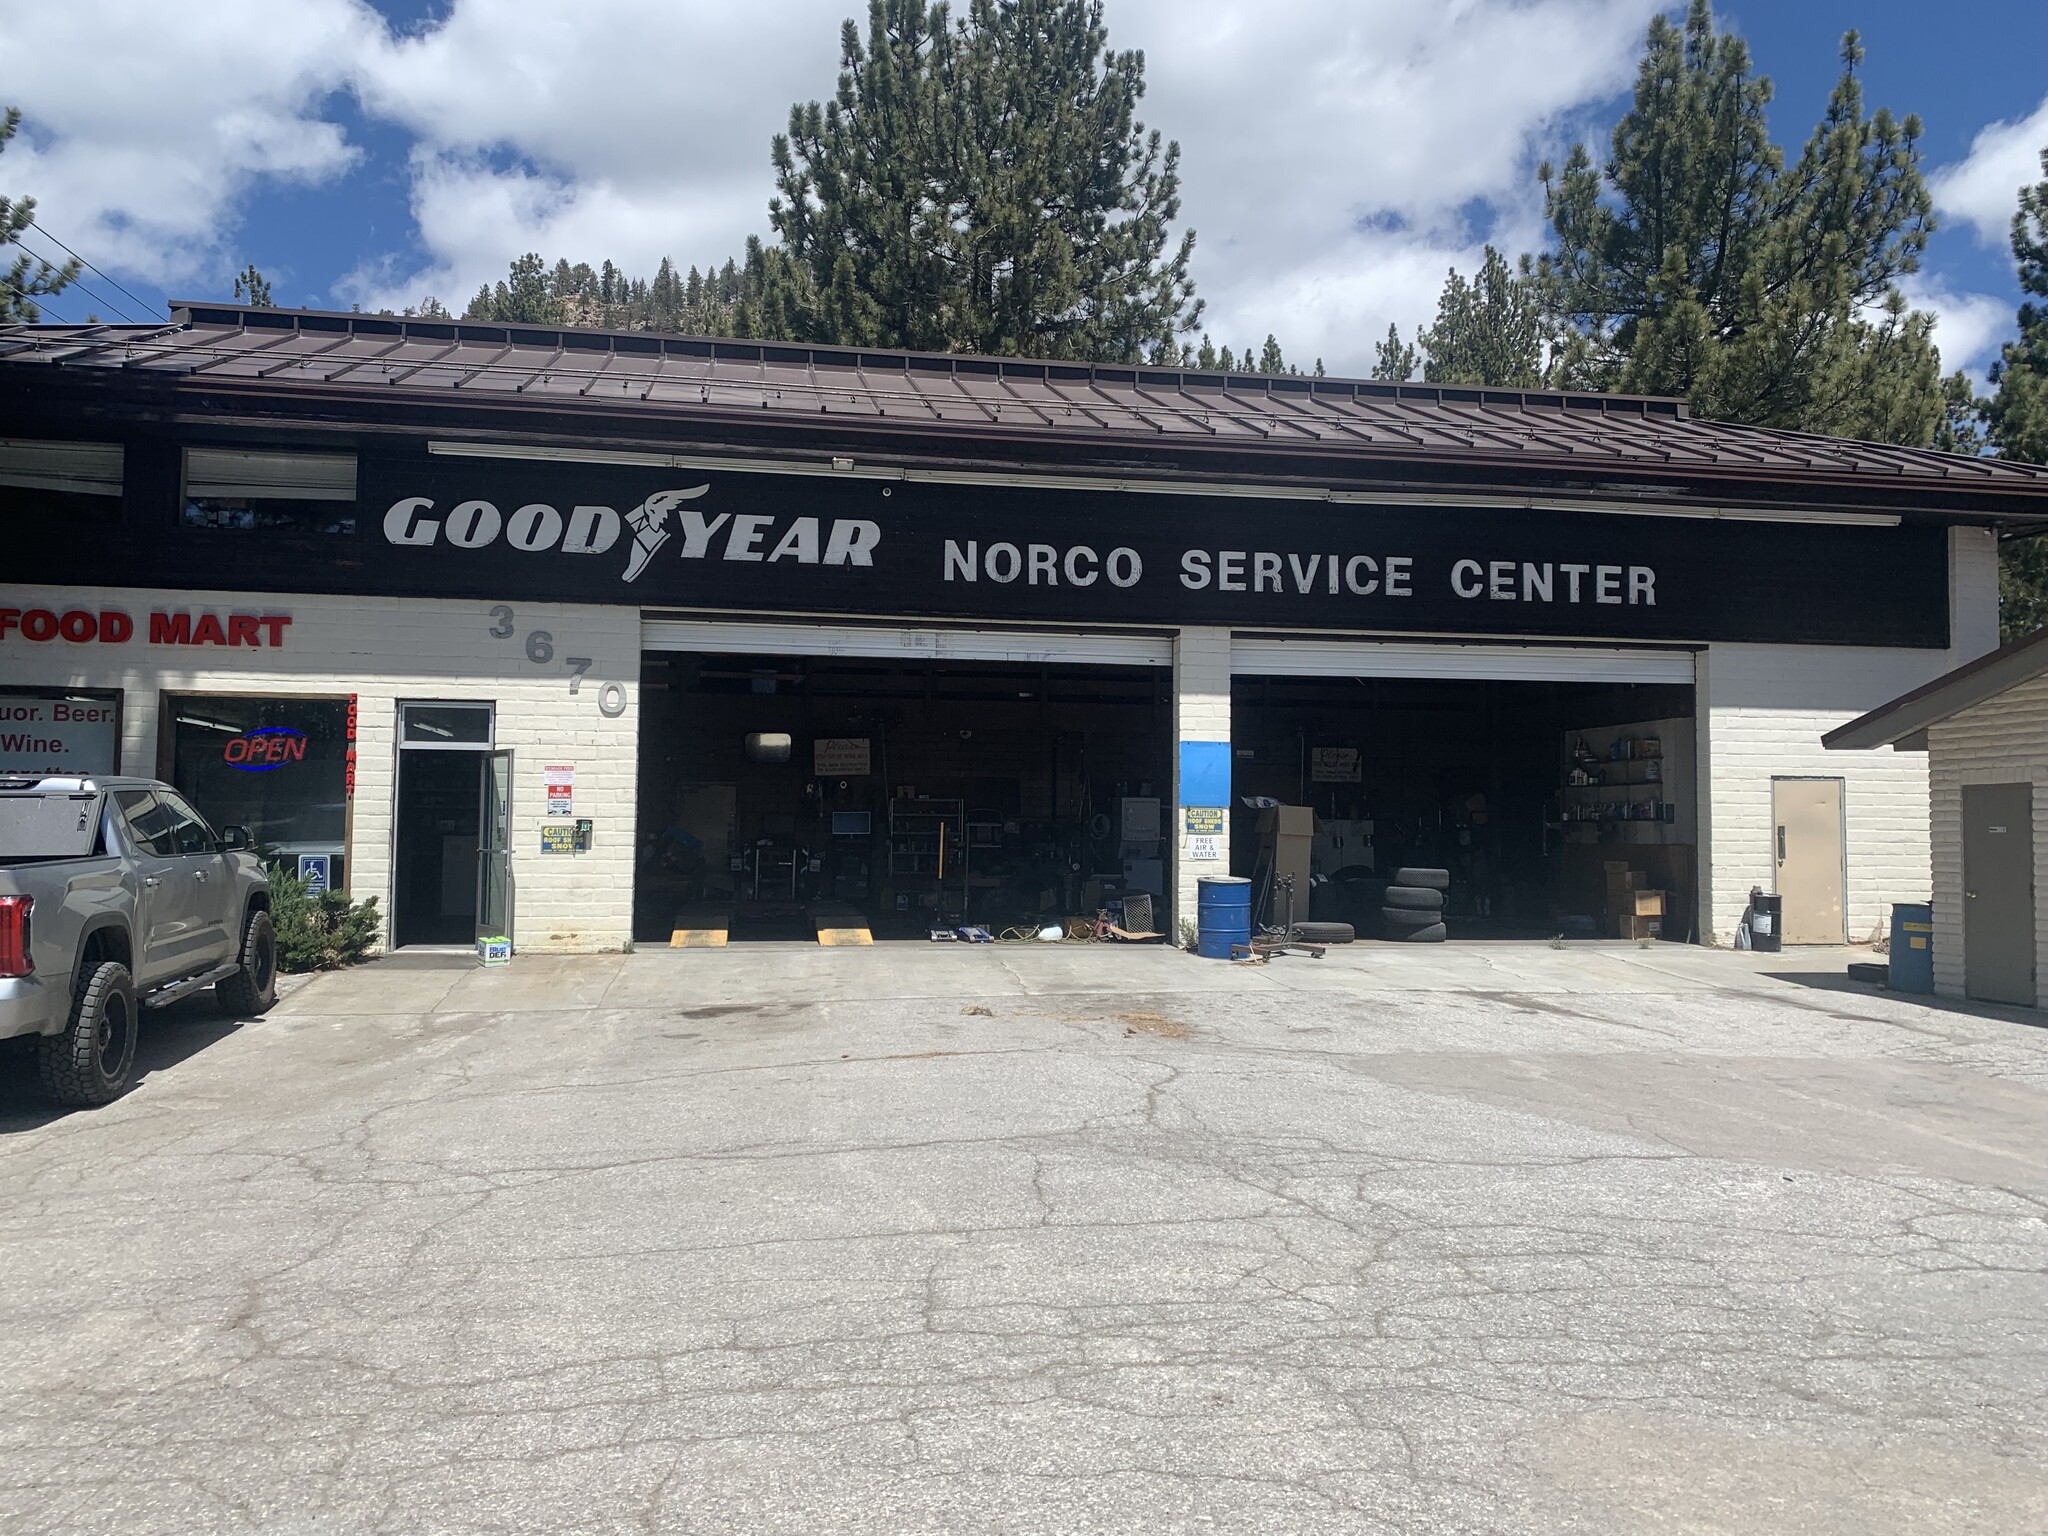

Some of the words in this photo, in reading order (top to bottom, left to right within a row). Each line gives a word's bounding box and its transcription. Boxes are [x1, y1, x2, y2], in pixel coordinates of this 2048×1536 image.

[943, 538, 1143, 588] NORCO
[1179, 549, 1414, 598] SERVICE
[1450, 559, 1657, 607] CENTER
[0, 608, 134, 643] FOOD
[149, 612, 293, 647] MART
[53, 703, 115, 723] Beer.
[346, 693, 357, 739] FOOD
[1, 734, 69, 753] Wine.
[223, 737, 308, 762] OPEN
[345, 750, 356, 793] MART
